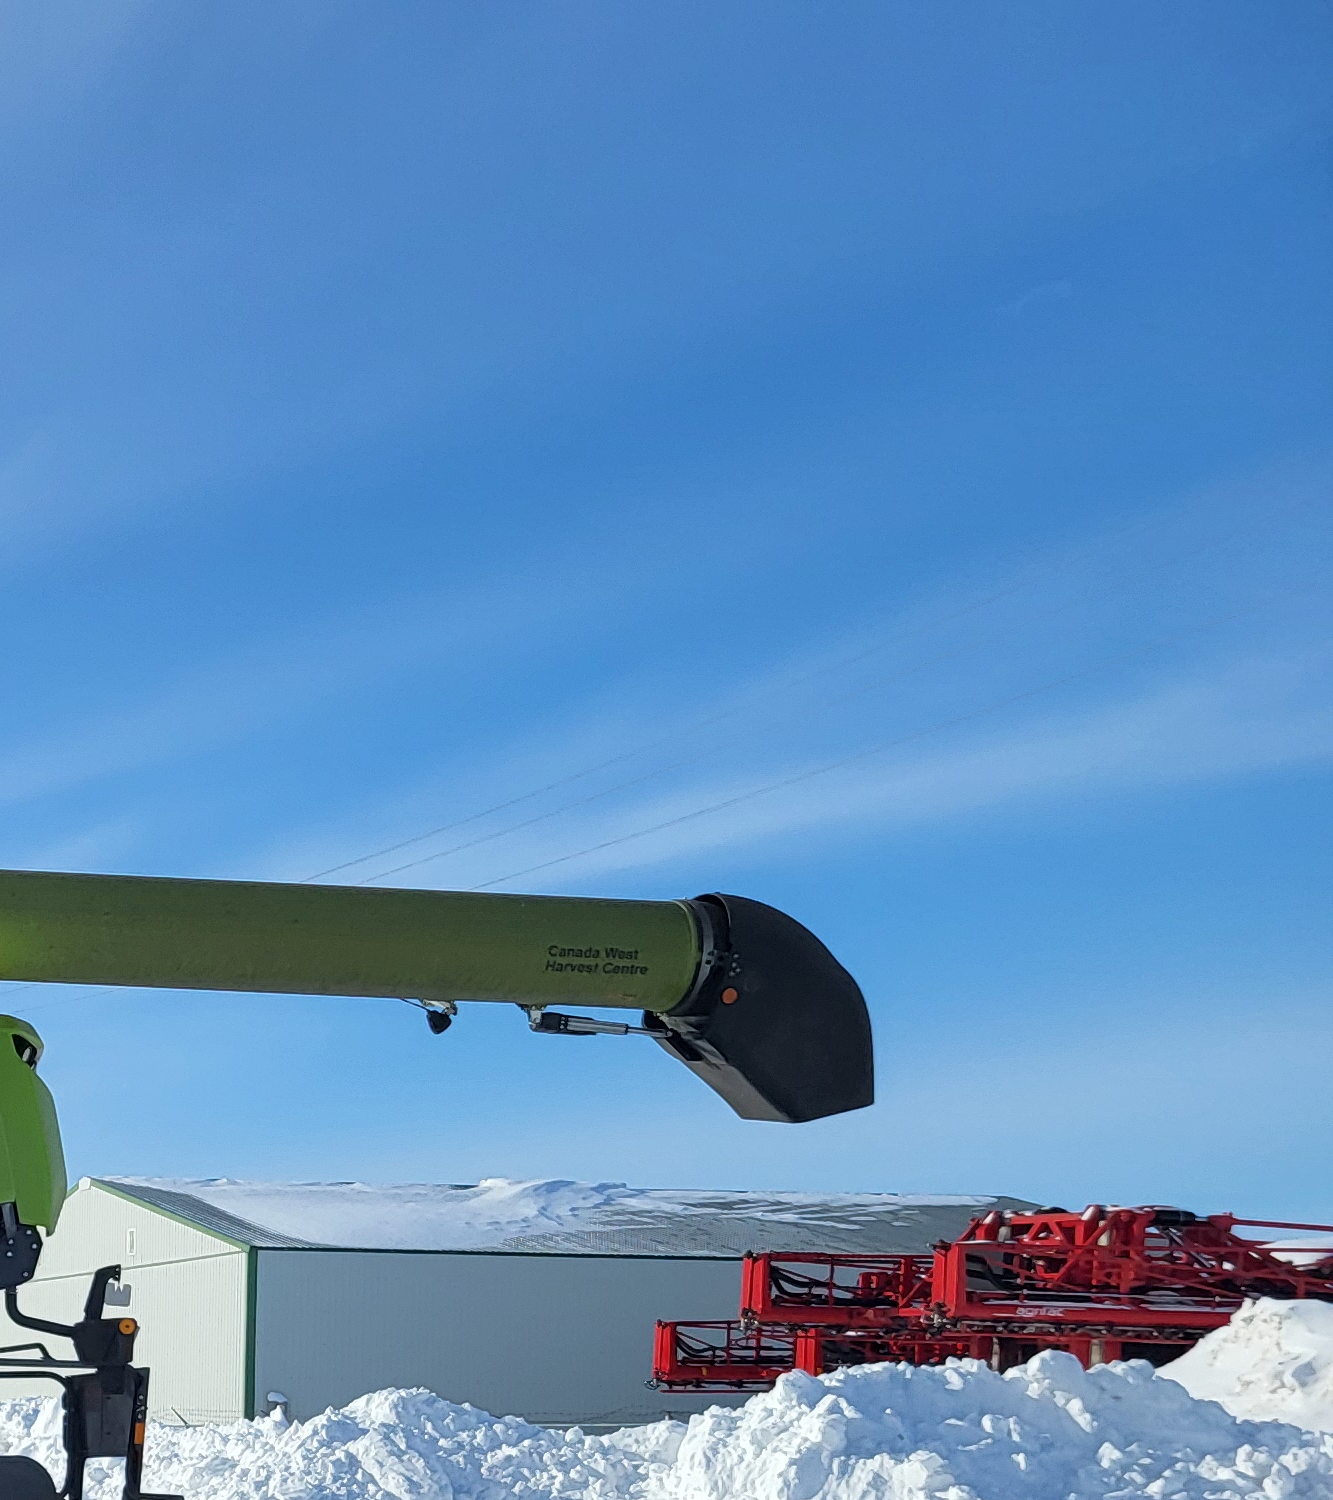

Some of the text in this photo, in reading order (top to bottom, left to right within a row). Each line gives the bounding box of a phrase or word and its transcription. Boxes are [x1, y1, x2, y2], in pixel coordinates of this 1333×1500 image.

[548, 945, 640, 960] Canada West
[545, 960, 649, 976] Harvest Centre
